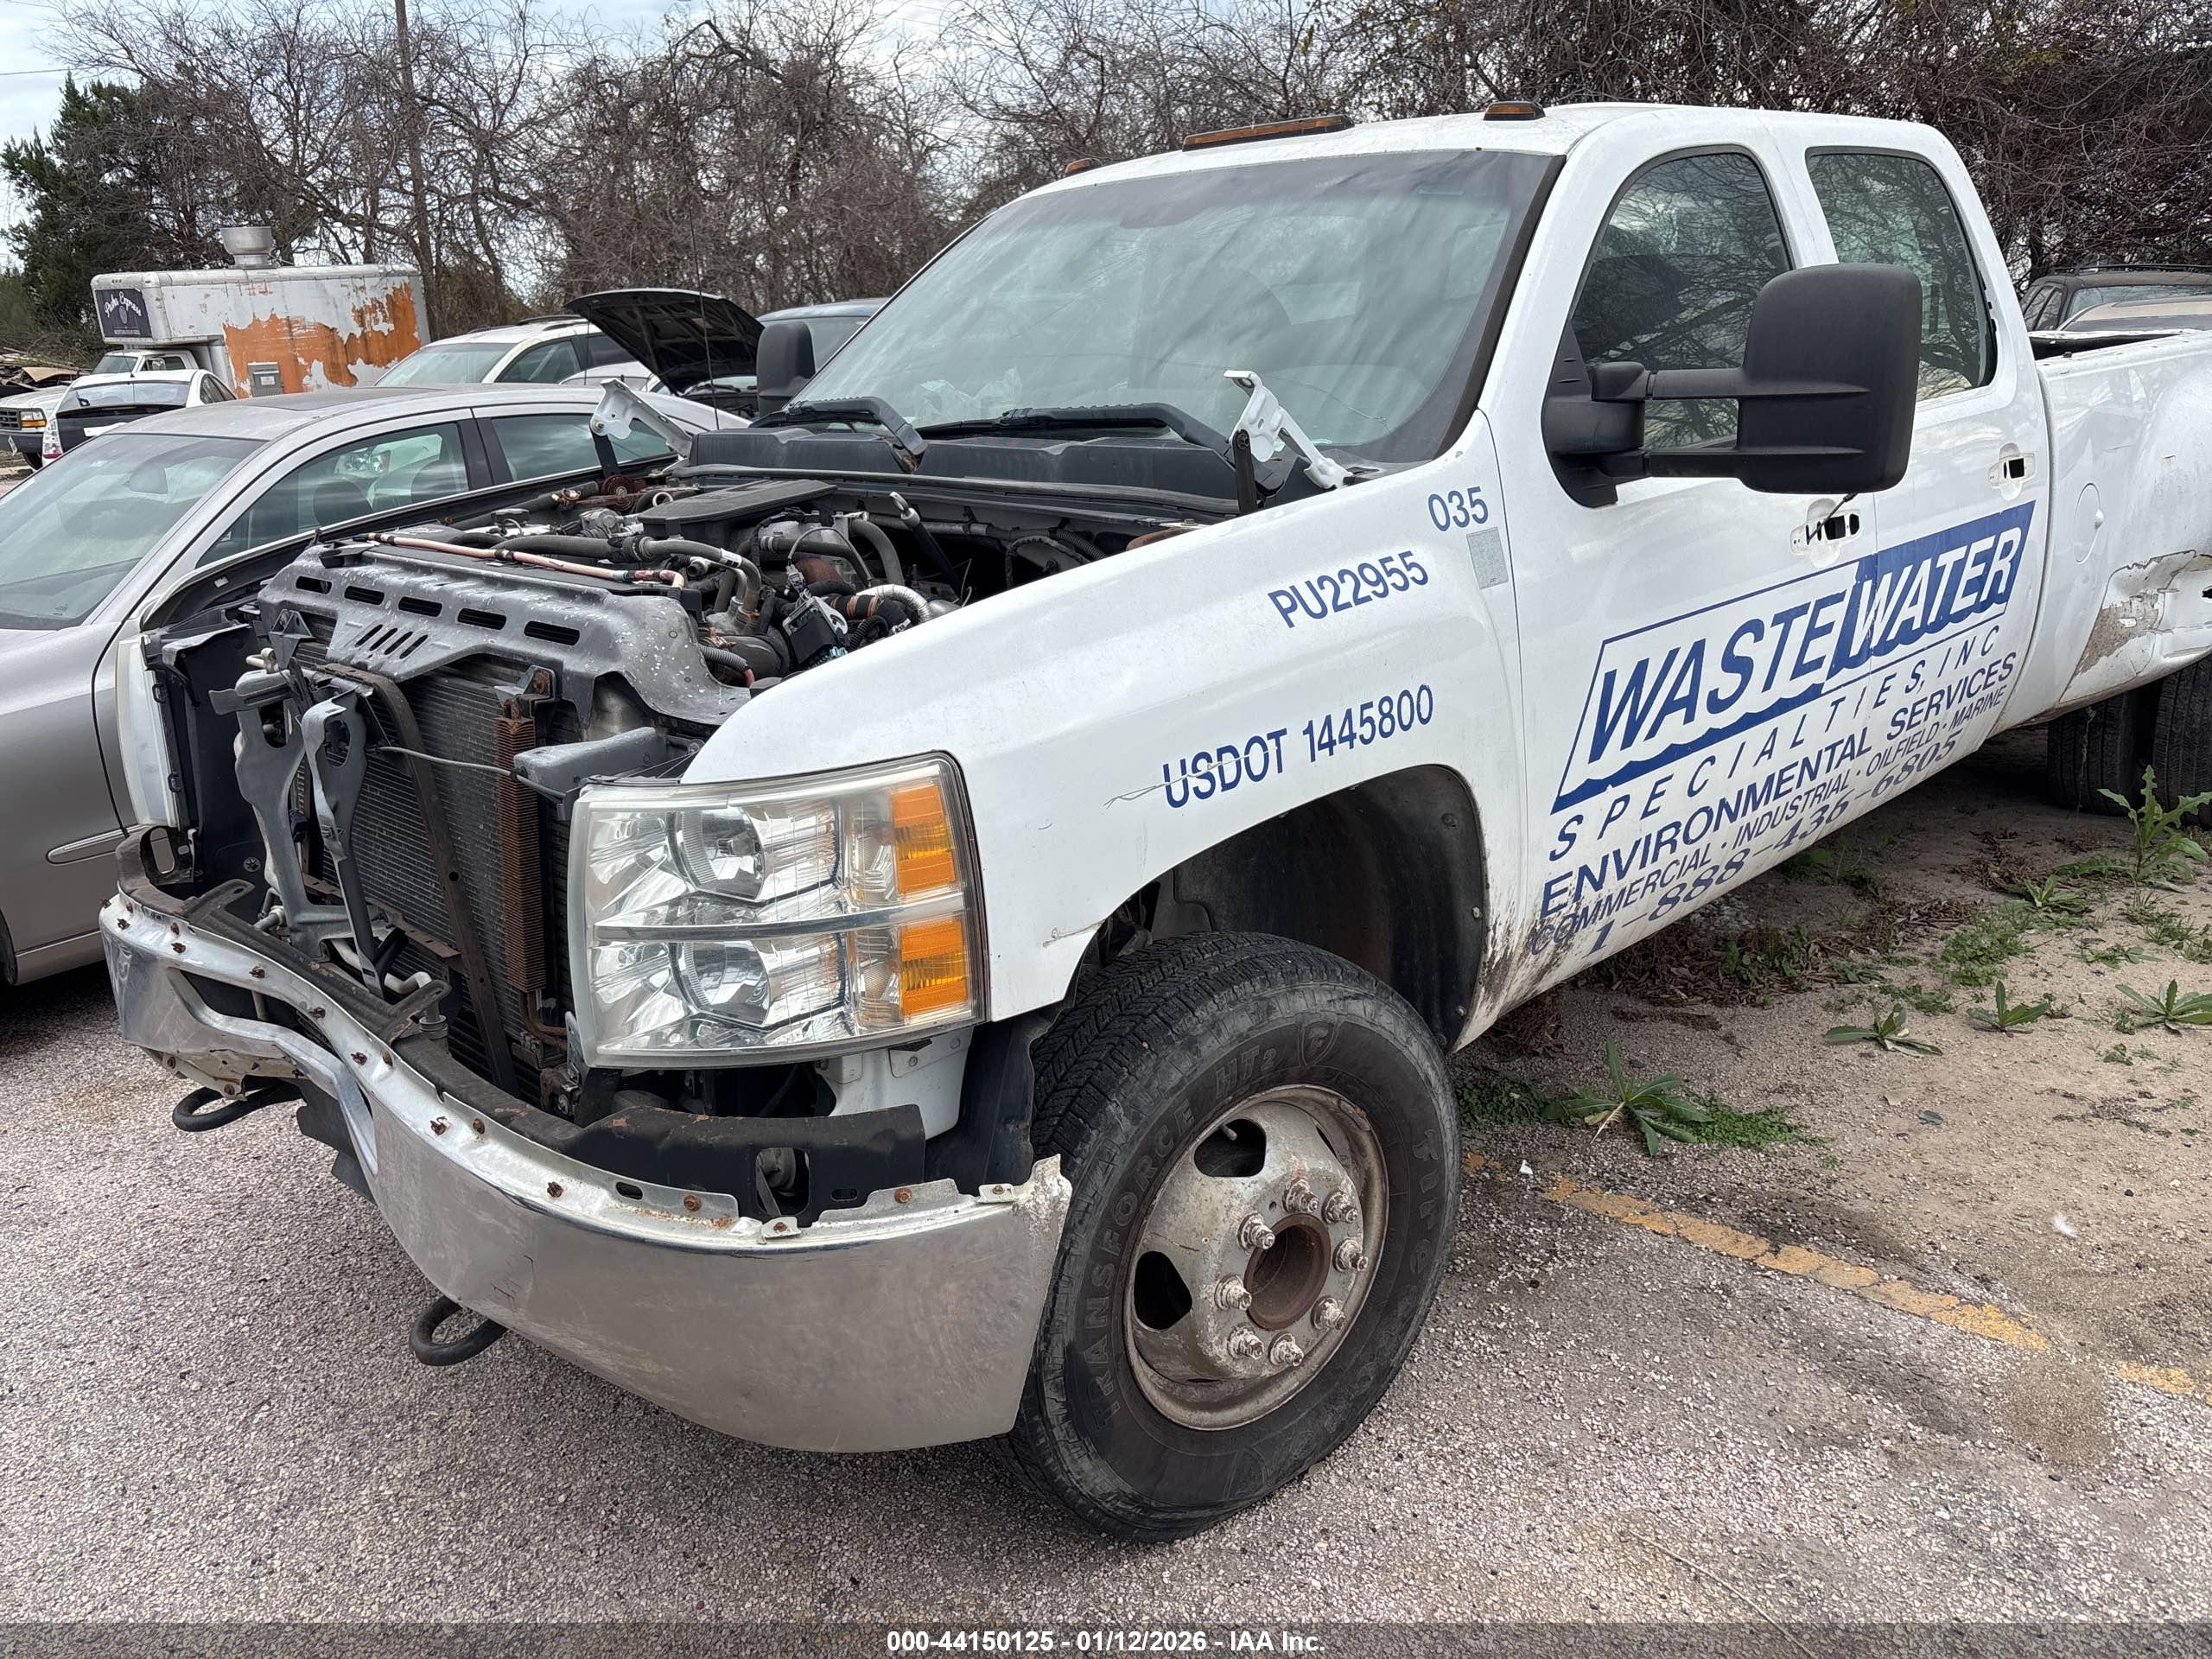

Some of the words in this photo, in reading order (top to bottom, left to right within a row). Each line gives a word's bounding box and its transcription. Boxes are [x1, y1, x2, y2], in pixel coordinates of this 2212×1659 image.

[1268, 550, 1428, 628] PU22955
[1427, 486, 1489, 531] 035
[1938, 626, 1999, 678] INC
[1162, 728, 1287, 808] USDOT
[1302, 684, 1433, 762] 1445800
[1531, 842, 1712, 955] COMMERCIAL
[1732, 768, 1851, 850] INDUSTRIAL
[1866, 722, 1941, 778] OILFIELD
[1948, 685, 2008, 732] MARINE
[1539, 727, 1872, 919] ENVIRONMENTAL
[1886, 652, 2016, 741] SERVICES
[1582, 729, 1963, 957] 1-888-436-6805
[1084, 1098, 1196, 1431] TRANSFORCE
